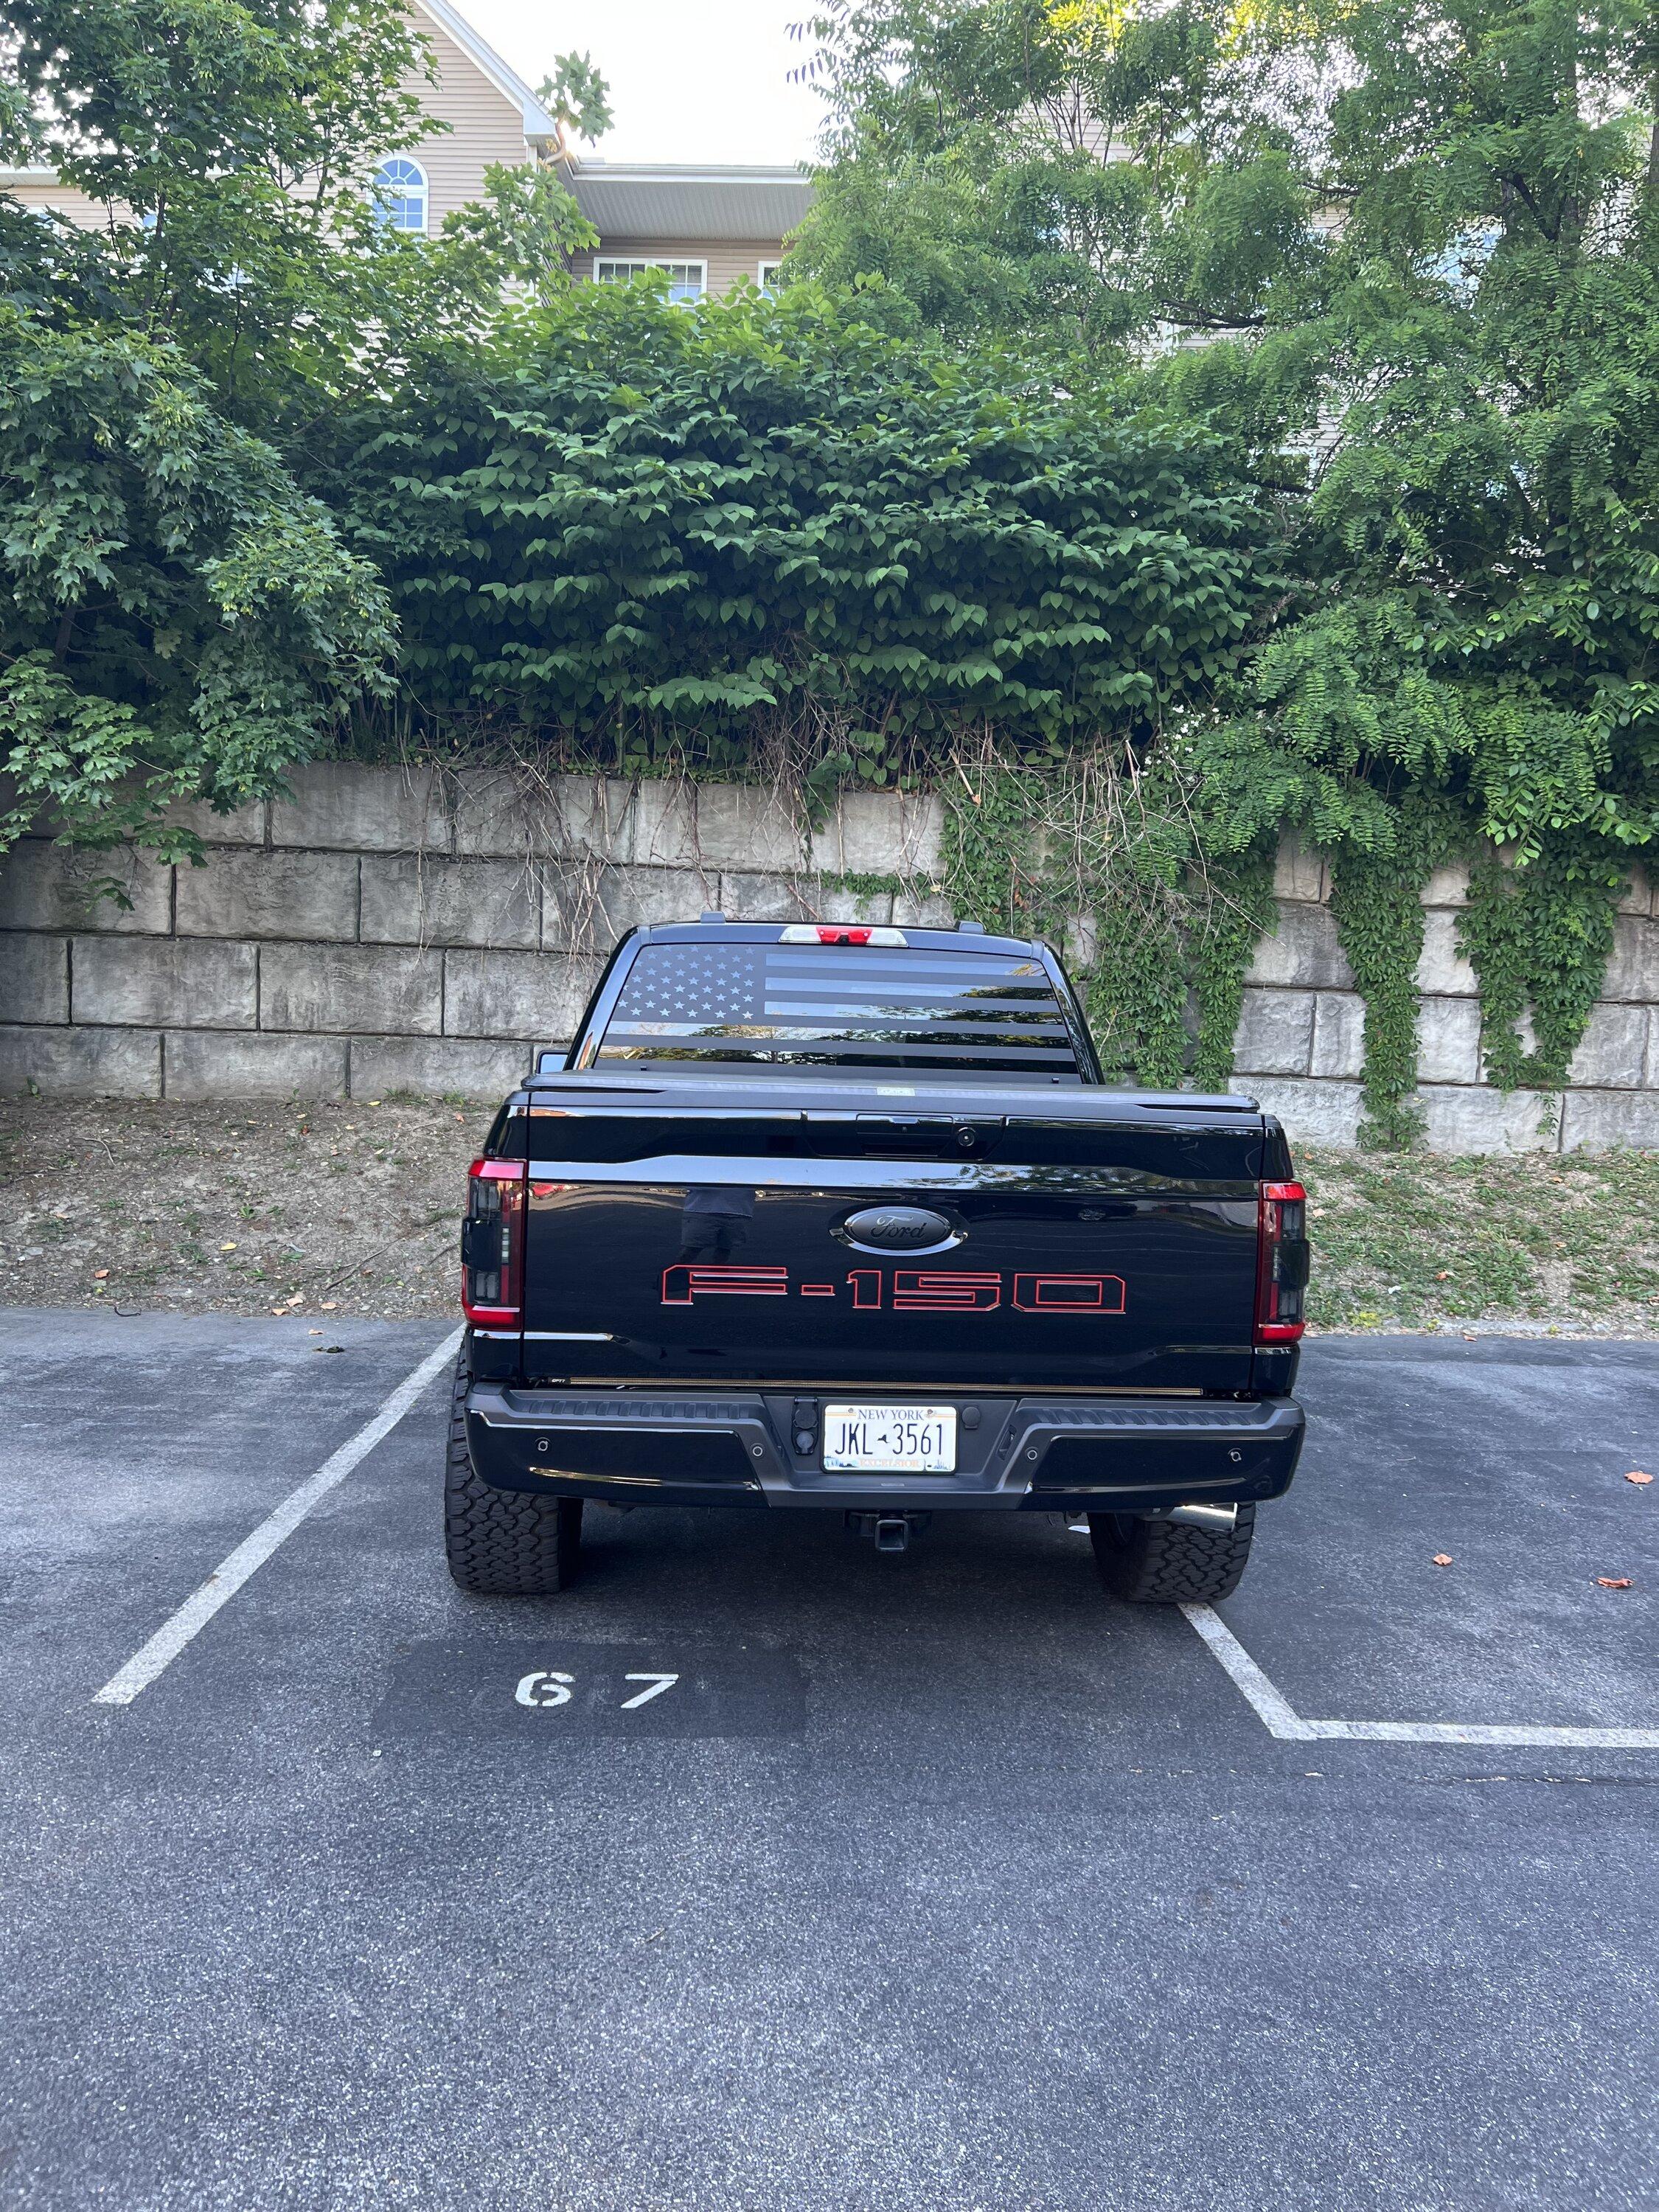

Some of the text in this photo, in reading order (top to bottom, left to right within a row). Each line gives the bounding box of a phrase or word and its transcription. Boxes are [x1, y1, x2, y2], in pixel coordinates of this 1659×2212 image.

[871, 1215, 927, 1238] Ford
[661, 1264, 1125, 1313] F-150
[858, 1409, 924, 1420] NEW YORK
[835, 1423, 942, 1455] JKL 3561
